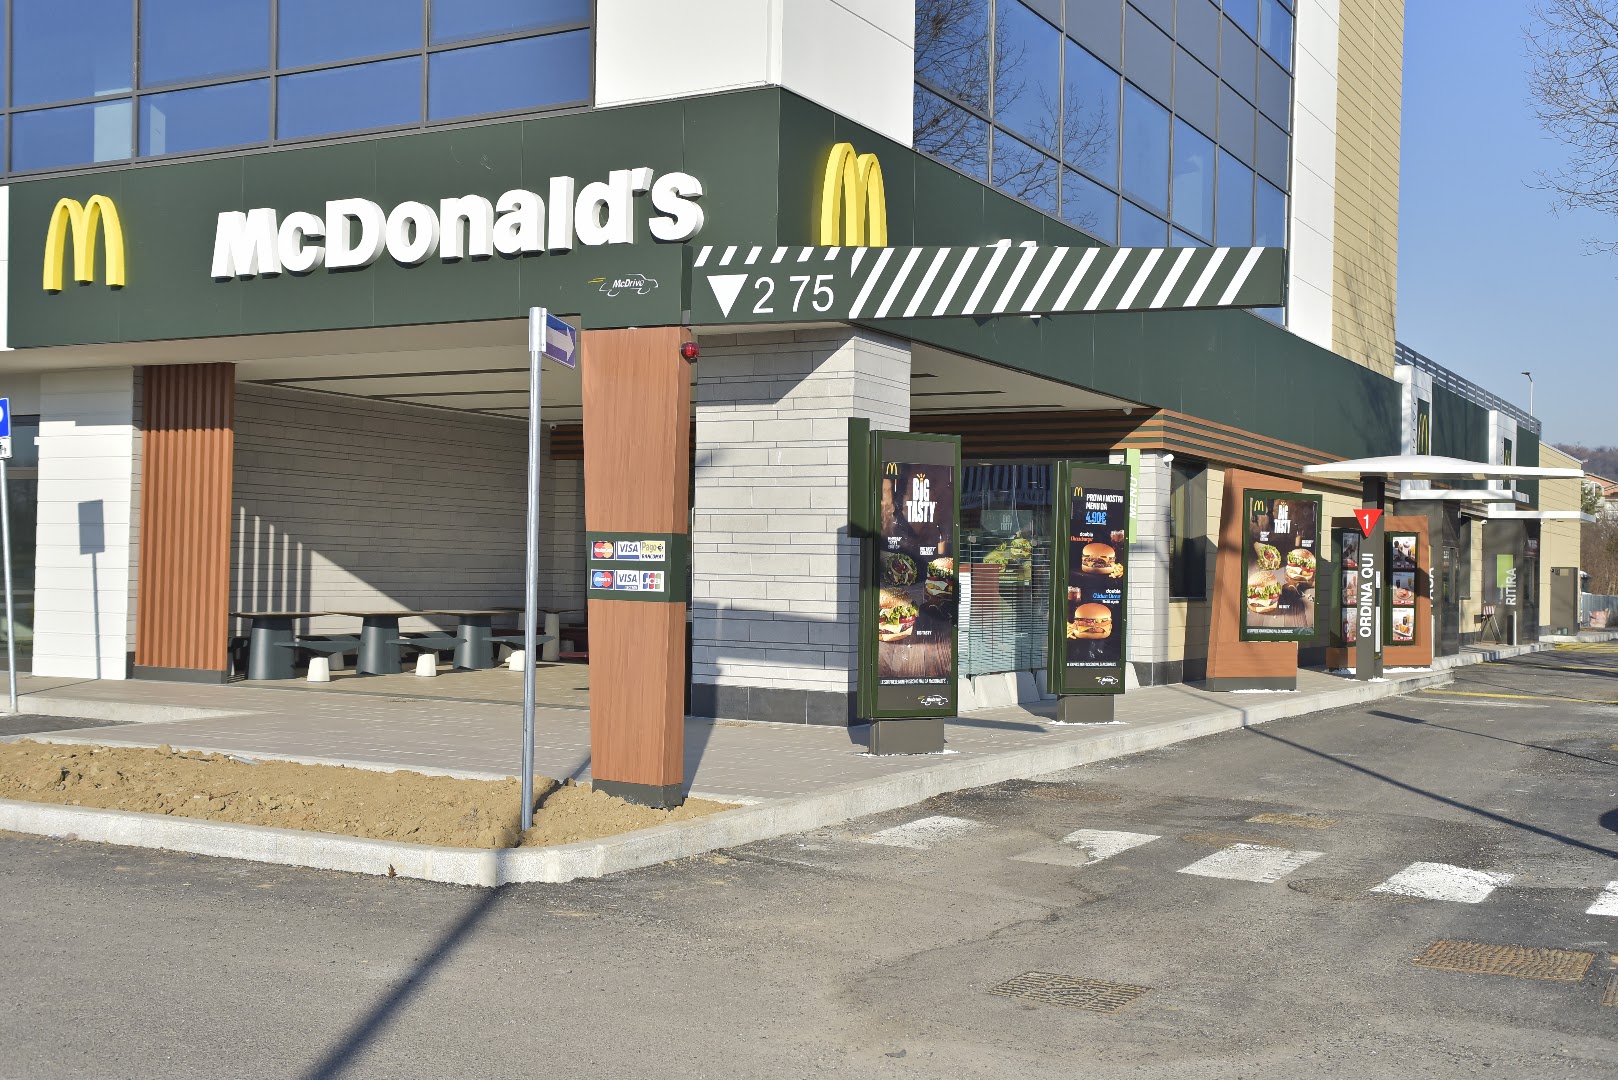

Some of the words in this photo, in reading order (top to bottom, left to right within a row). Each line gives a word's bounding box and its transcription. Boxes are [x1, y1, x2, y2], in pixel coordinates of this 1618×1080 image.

[211, 166, 704, 279] McDonald's
[613, 278, 644, 288] McDrive
[752, 276, 775, 314] 2
[789, 274, 834, 313] 75
[912, 477, 930, 501] BIG
[1086, 493, 1102, 502] PROVA
[1105, 494, 1124, 503] NOSTRI
[906, 501, 936, 522] TASTY
[1278, 504, 1289, 520] BIG
[1274, 519, 1291, 534] TASTY
[1363, 514, 1369, 529] 1
[620, 544, 639, 553] VISA
[641, 542, 657, 553] Pago
[1361, 553, 1374, 579] QUI
[619, 573, 637, 582] VISA
[1505, 567, 1517, 606] RITIRA
[1359, 581, 1373, 638] ORDINA
